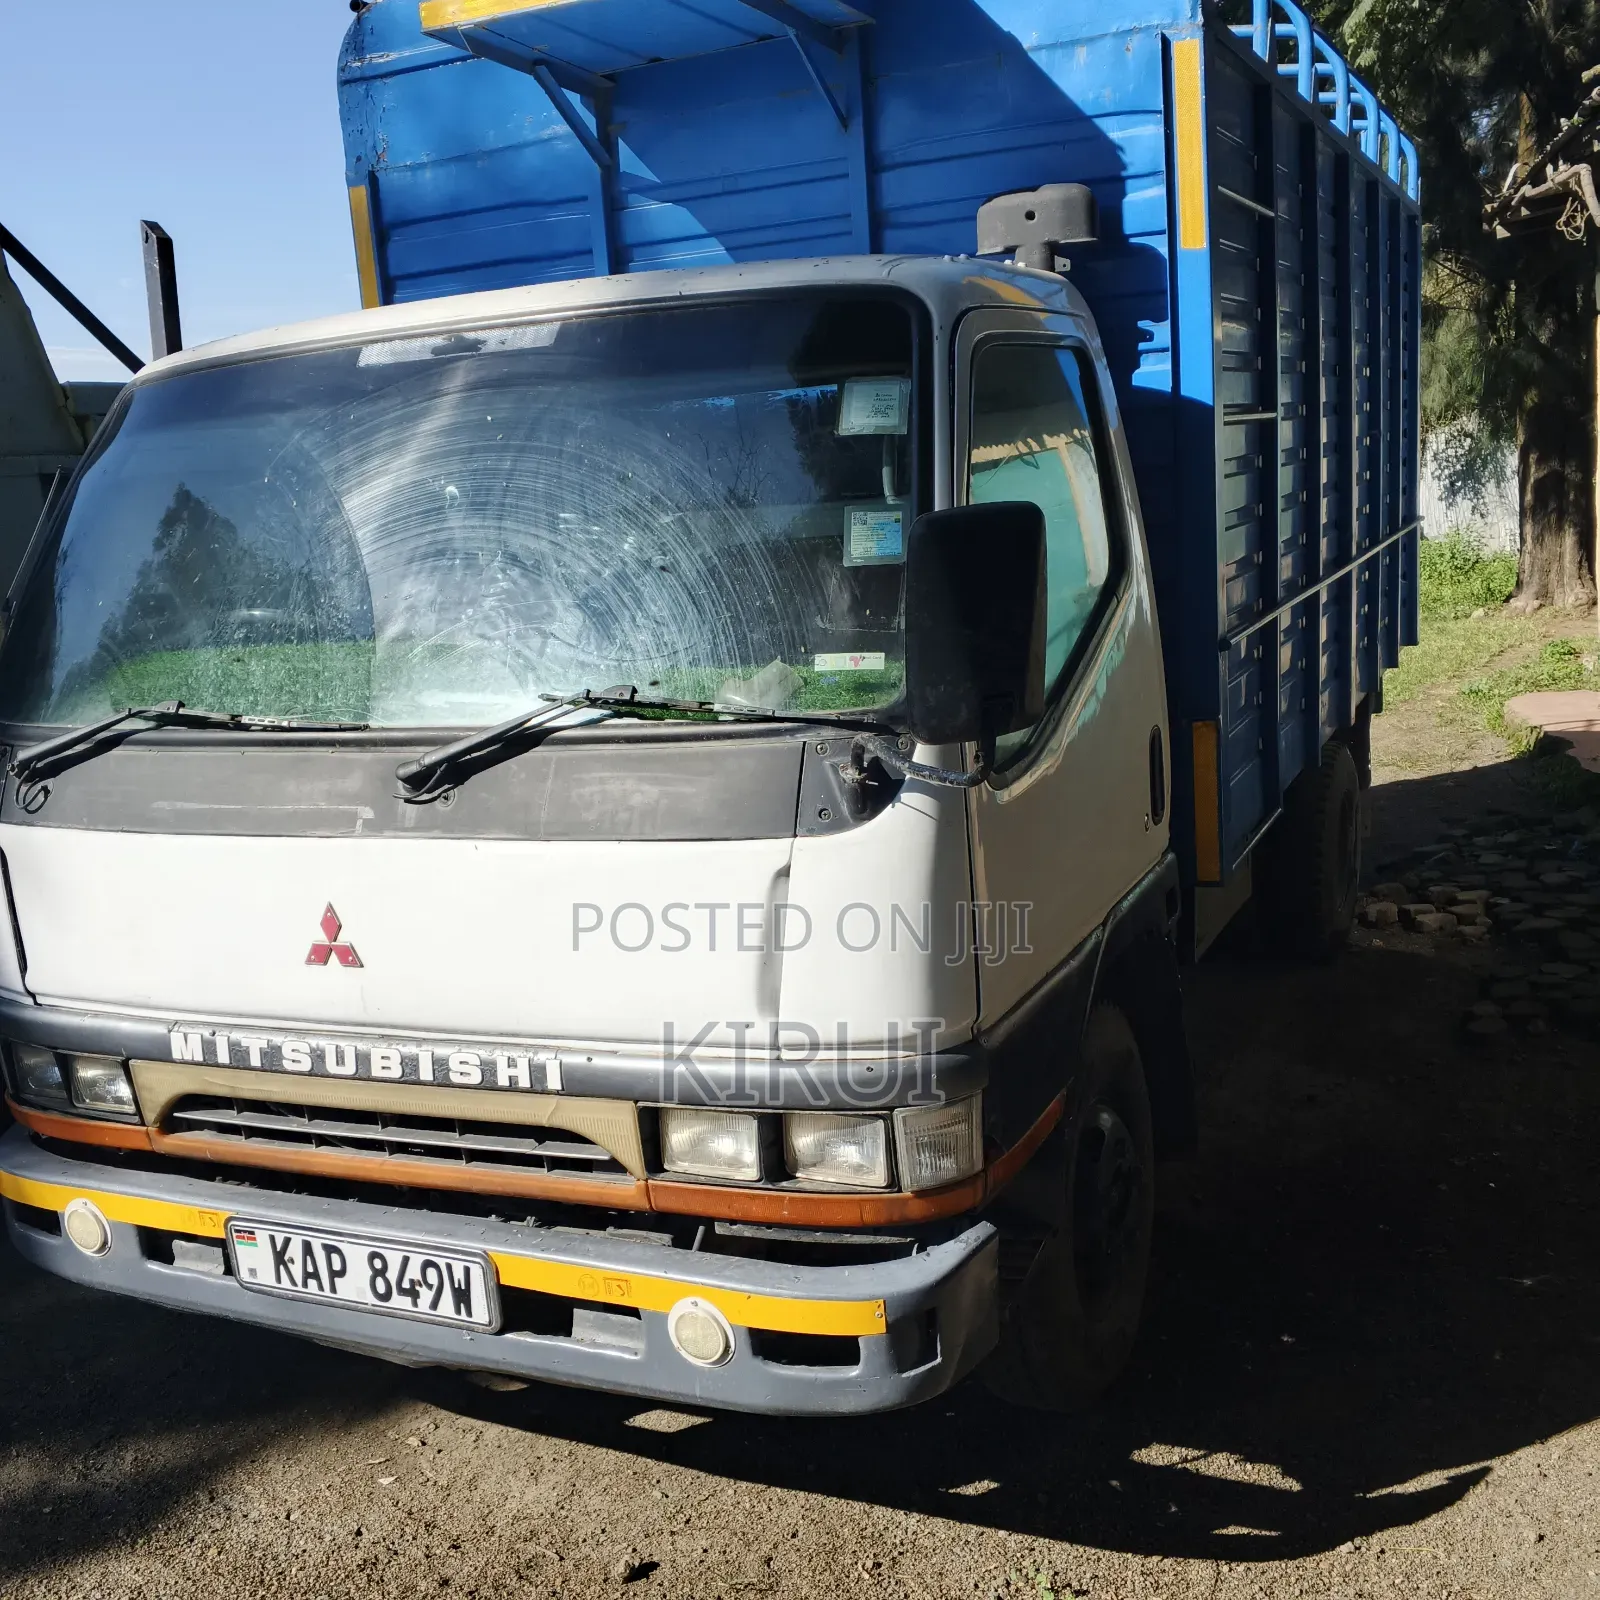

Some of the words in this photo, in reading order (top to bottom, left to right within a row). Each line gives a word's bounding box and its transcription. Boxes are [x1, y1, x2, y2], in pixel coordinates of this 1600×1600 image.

[169, 1031, 563, 1091] MITSUBISHI
[268, 1233, 348, 1295] KAP
[366, 1250, 473, 1319] 849W
